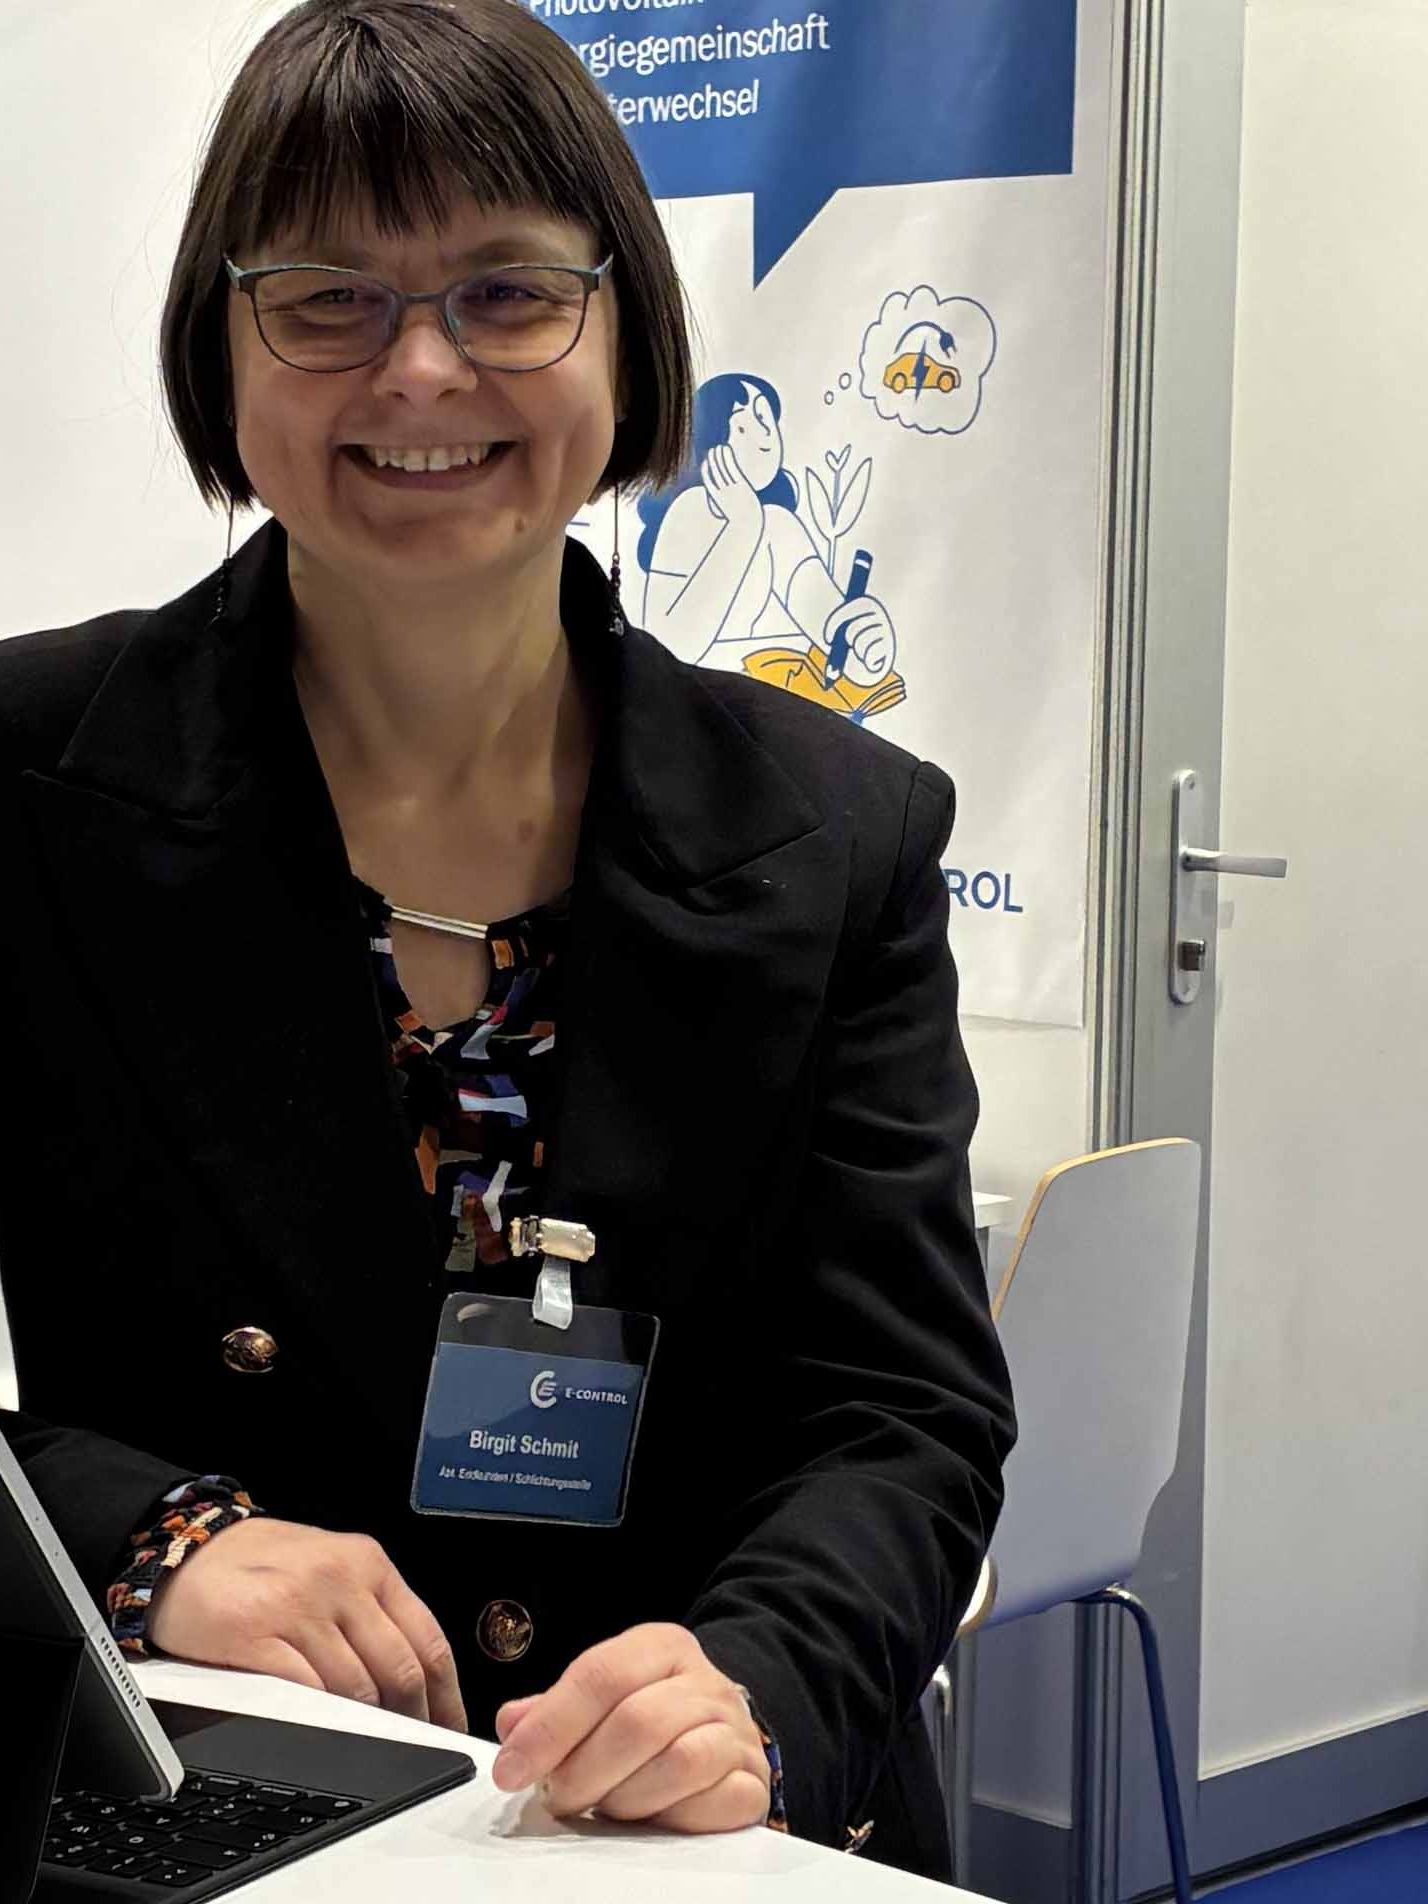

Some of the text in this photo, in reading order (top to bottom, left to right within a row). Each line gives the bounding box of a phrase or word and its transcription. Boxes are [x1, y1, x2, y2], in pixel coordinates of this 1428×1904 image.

[571, 13, 830, 78] rgiegemeinschaft
[607, 79, 760, 126] terwechsel
[470, 1430, 580, 1459] Birgit Schmit
